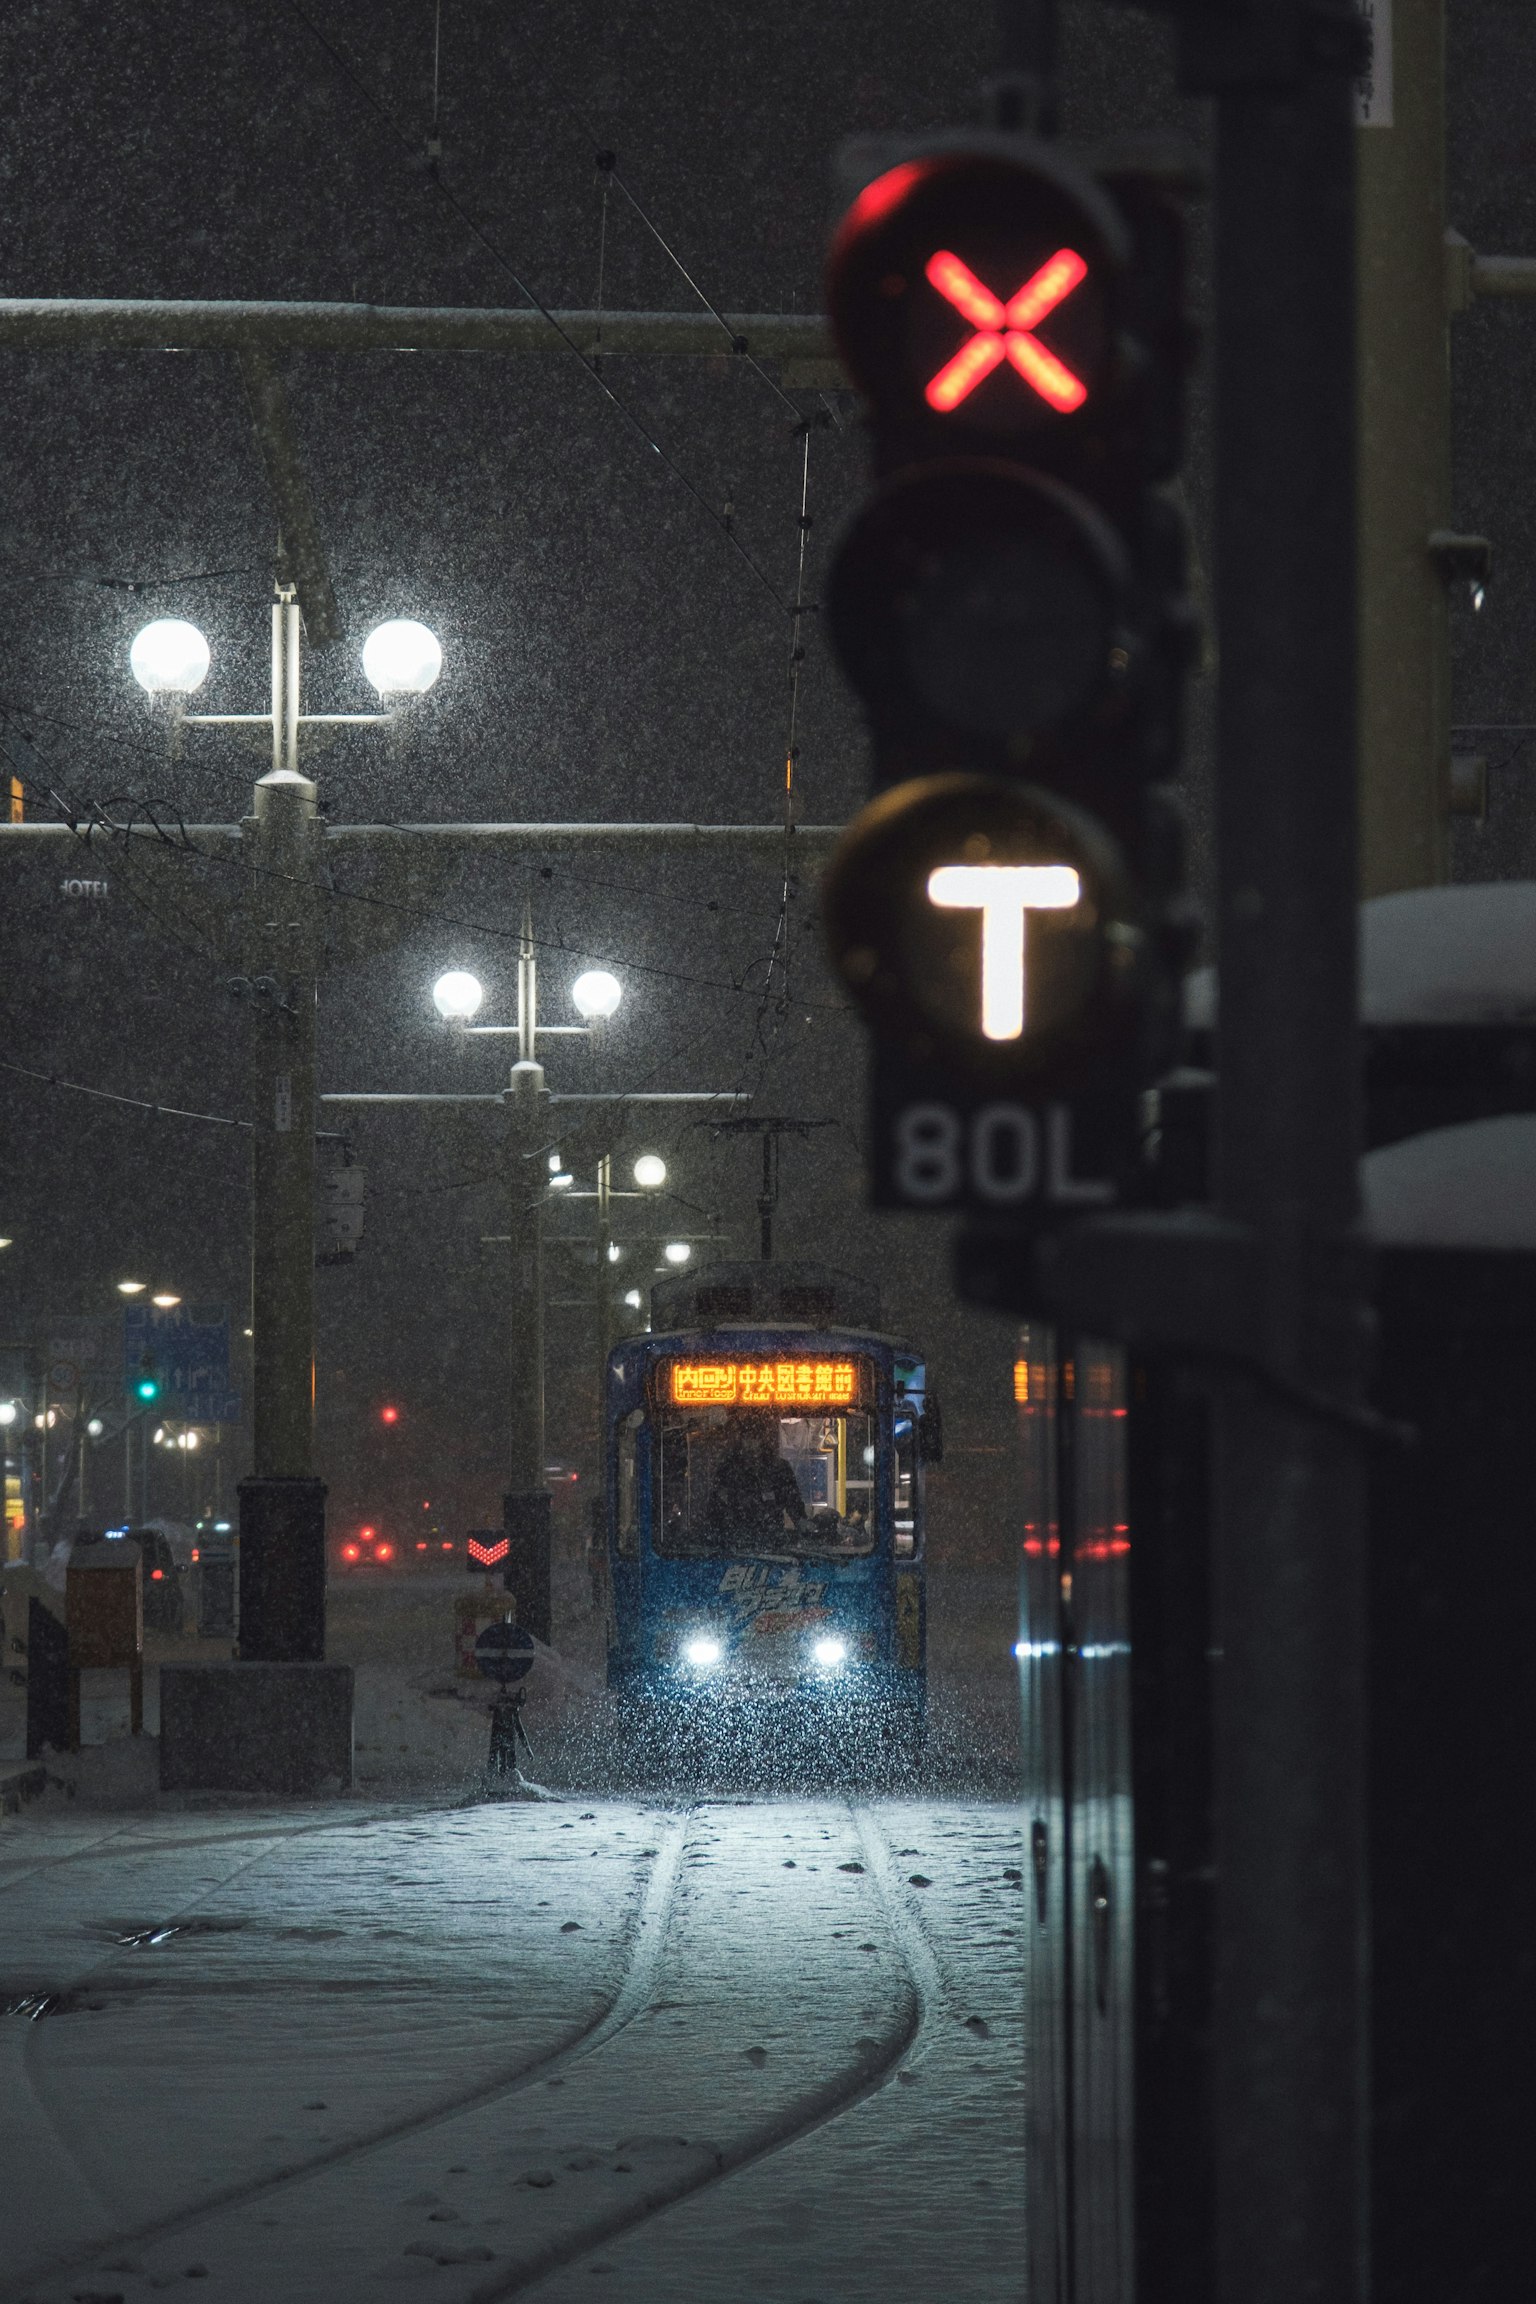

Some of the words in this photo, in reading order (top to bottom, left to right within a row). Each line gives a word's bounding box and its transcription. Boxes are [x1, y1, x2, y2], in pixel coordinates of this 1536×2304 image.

[927, 865, 1081, 1040] T
[898, 1102, 1115, 1199] 80L
[678, 1367, 734, 1389] 内回り
[739, 1364, 853, 1392] 中央図書館前
